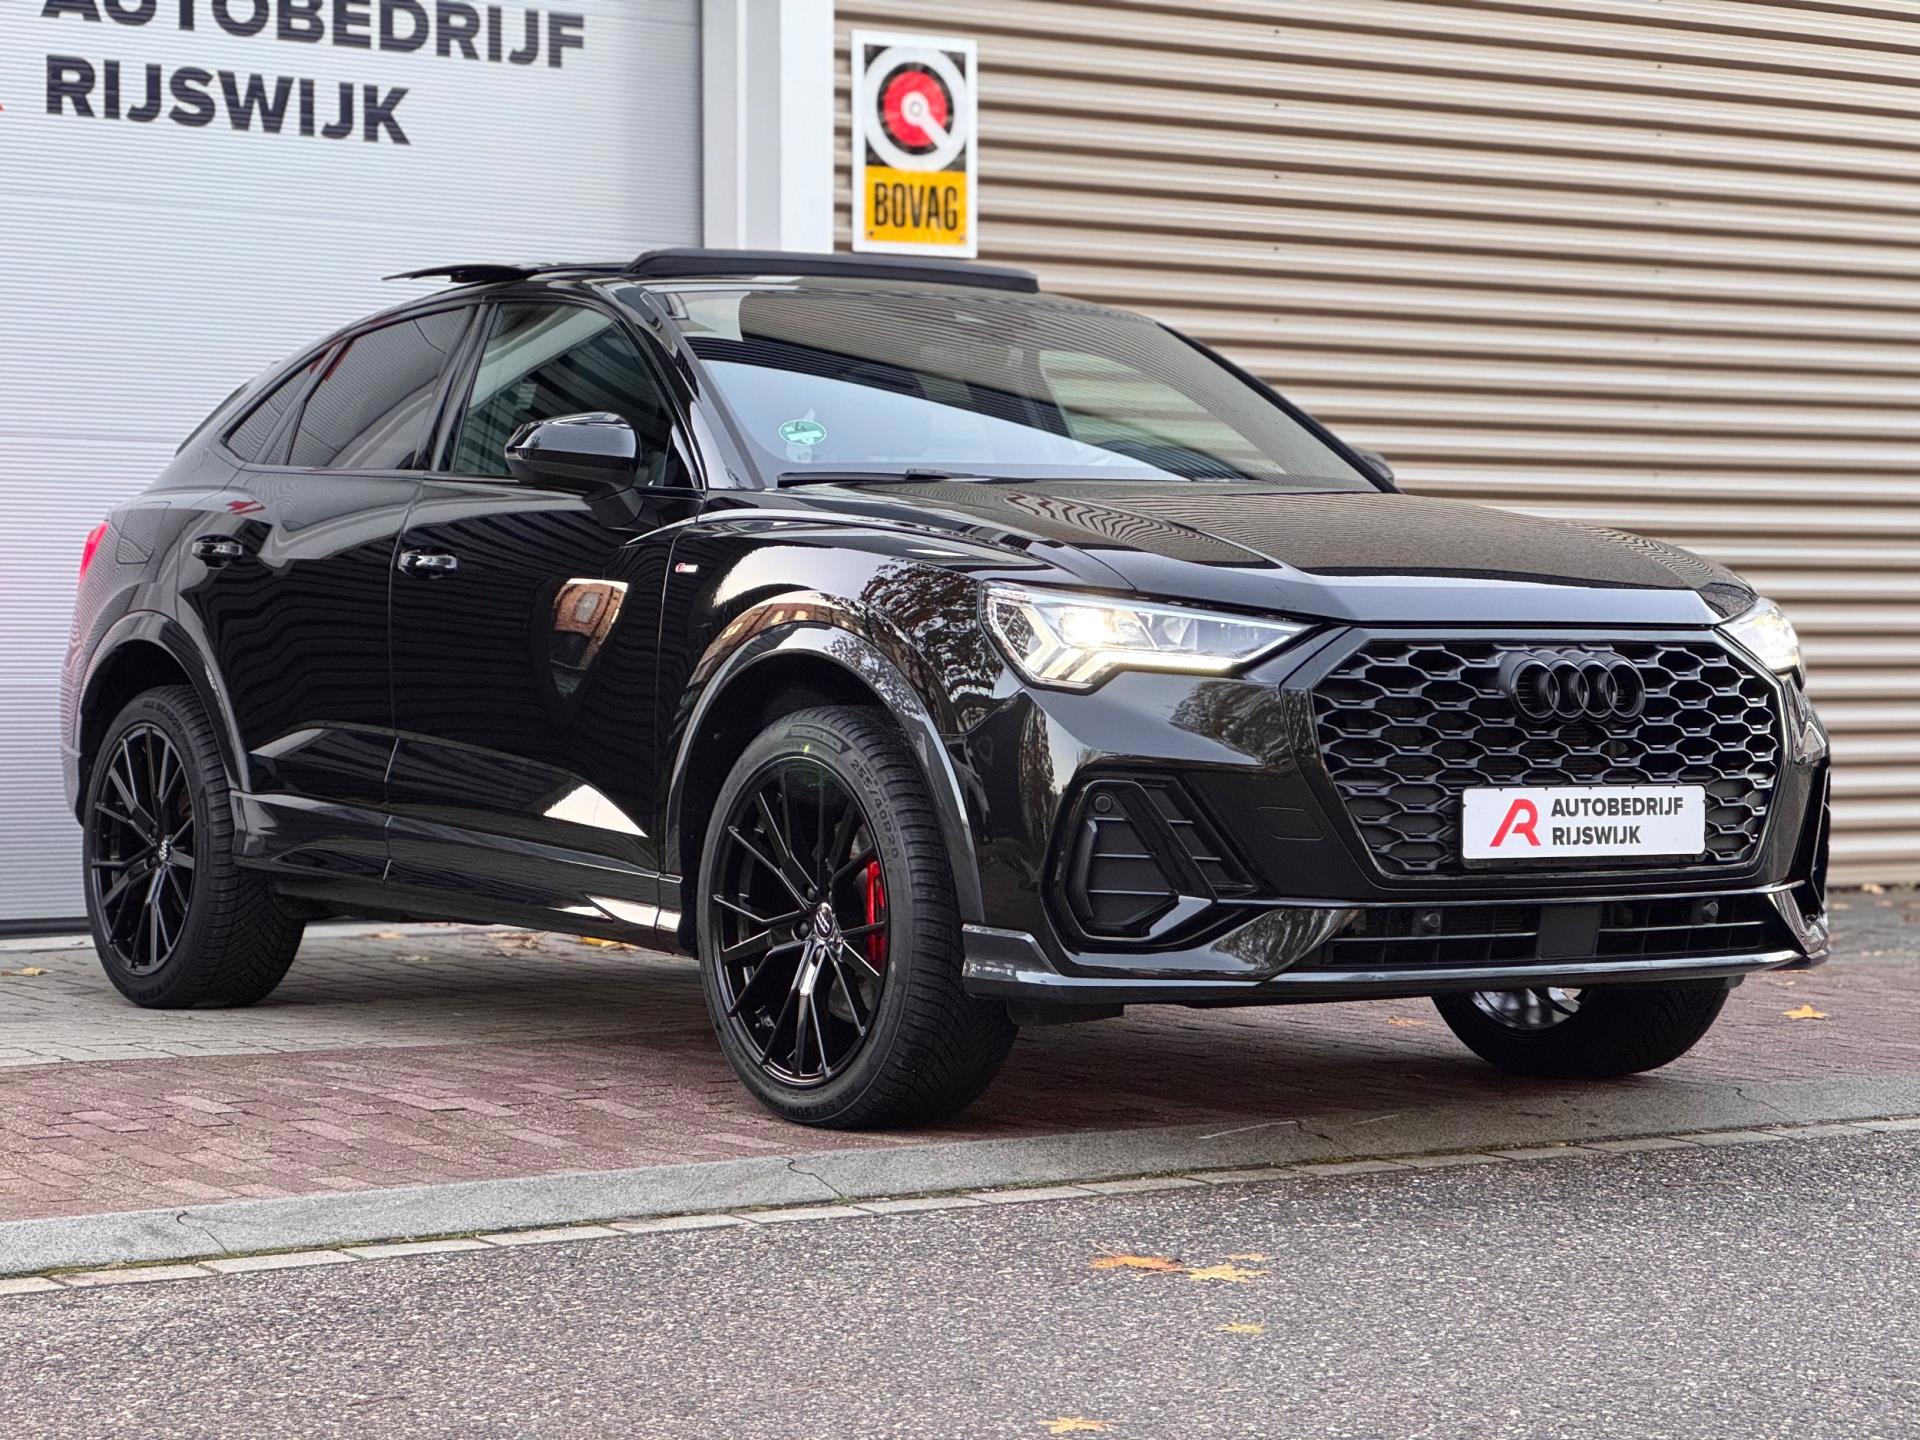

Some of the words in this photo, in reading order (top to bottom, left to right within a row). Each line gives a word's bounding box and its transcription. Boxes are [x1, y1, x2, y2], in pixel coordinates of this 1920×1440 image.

[46, 54, 410, 145] RIJSWIJK
[874, 182, 958, 231] BOVAG
[1551, 797, 1684, 817] AUTOBEDRIJF
[1552, 825, 1642, 846] RIJSWIJK
